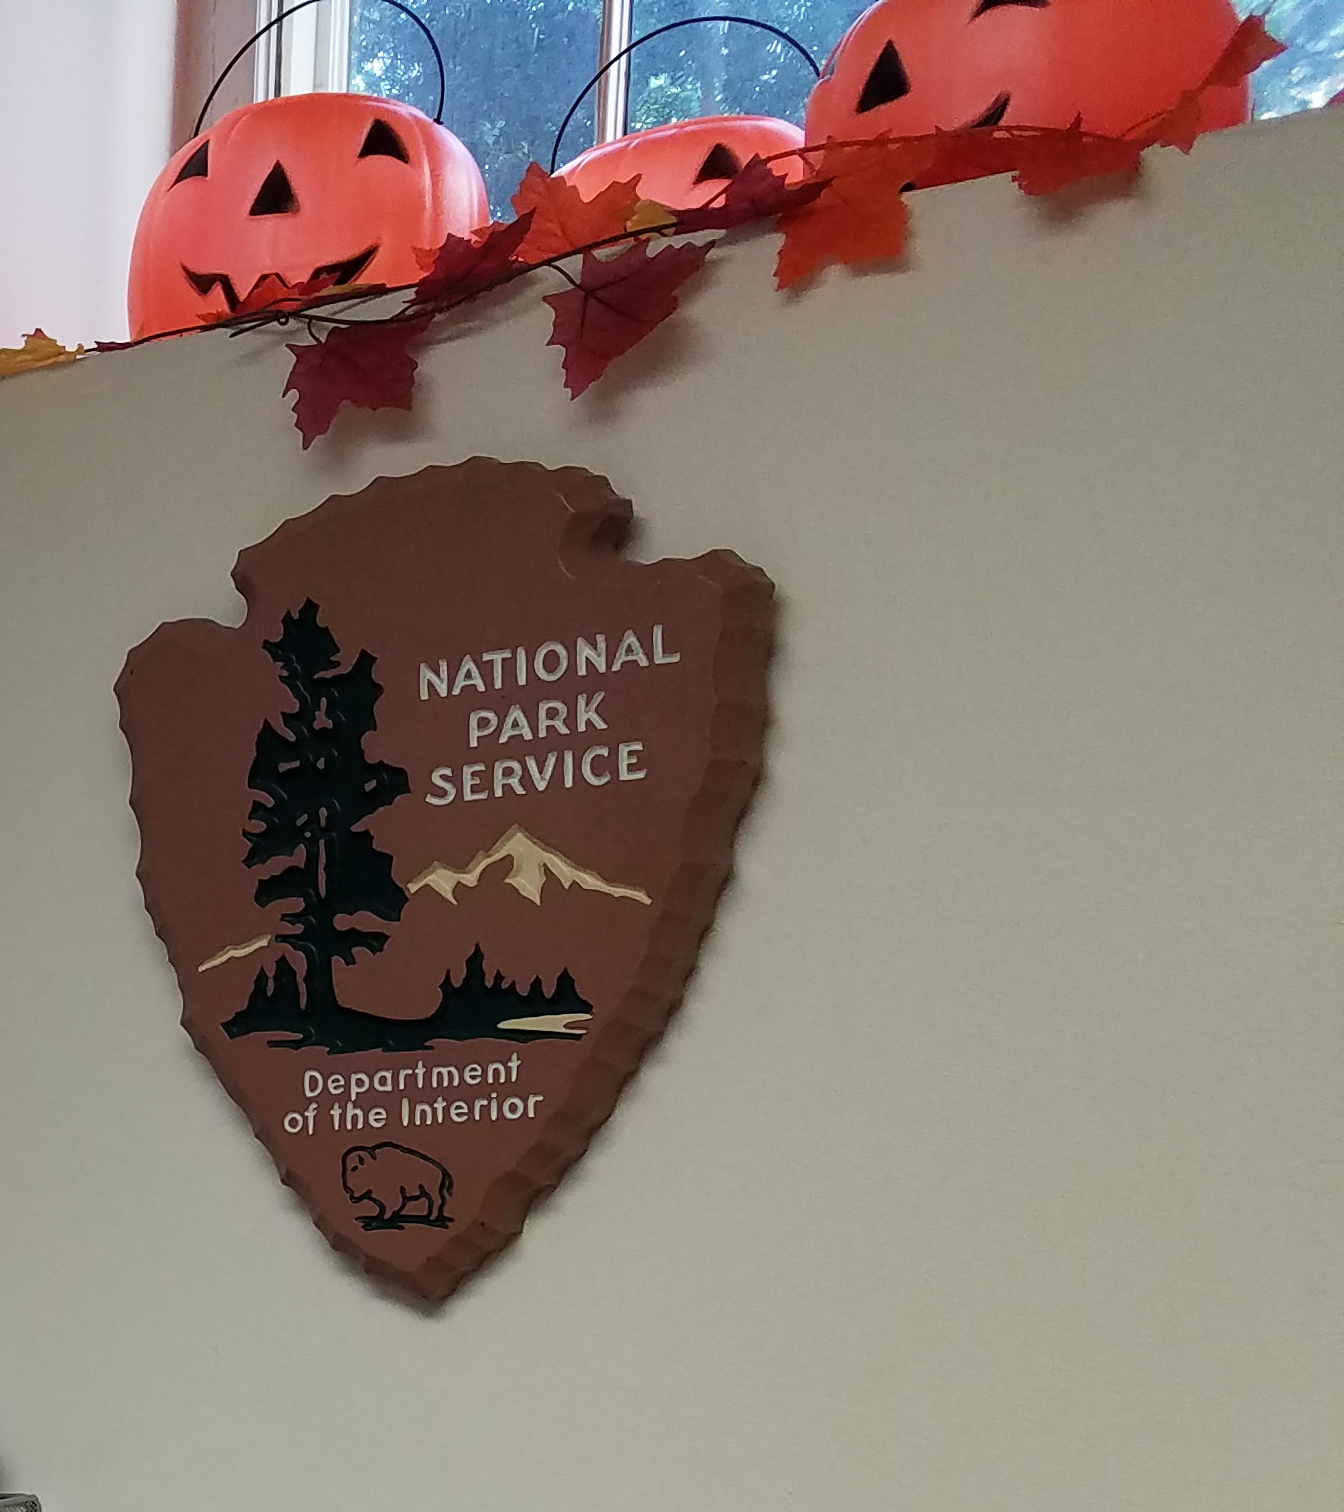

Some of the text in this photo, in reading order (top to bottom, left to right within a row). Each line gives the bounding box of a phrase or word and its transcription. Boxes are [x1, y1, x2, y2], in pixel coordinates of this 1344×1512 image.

[418, 624, 681, 701] NATIONAL
[468, 690, 608, 748] PARK
[425, 741, 648, 806] SERVICE
[303, 1051, 522, 1101] Department
[283, 1091, 544, 1135] of the Interior
